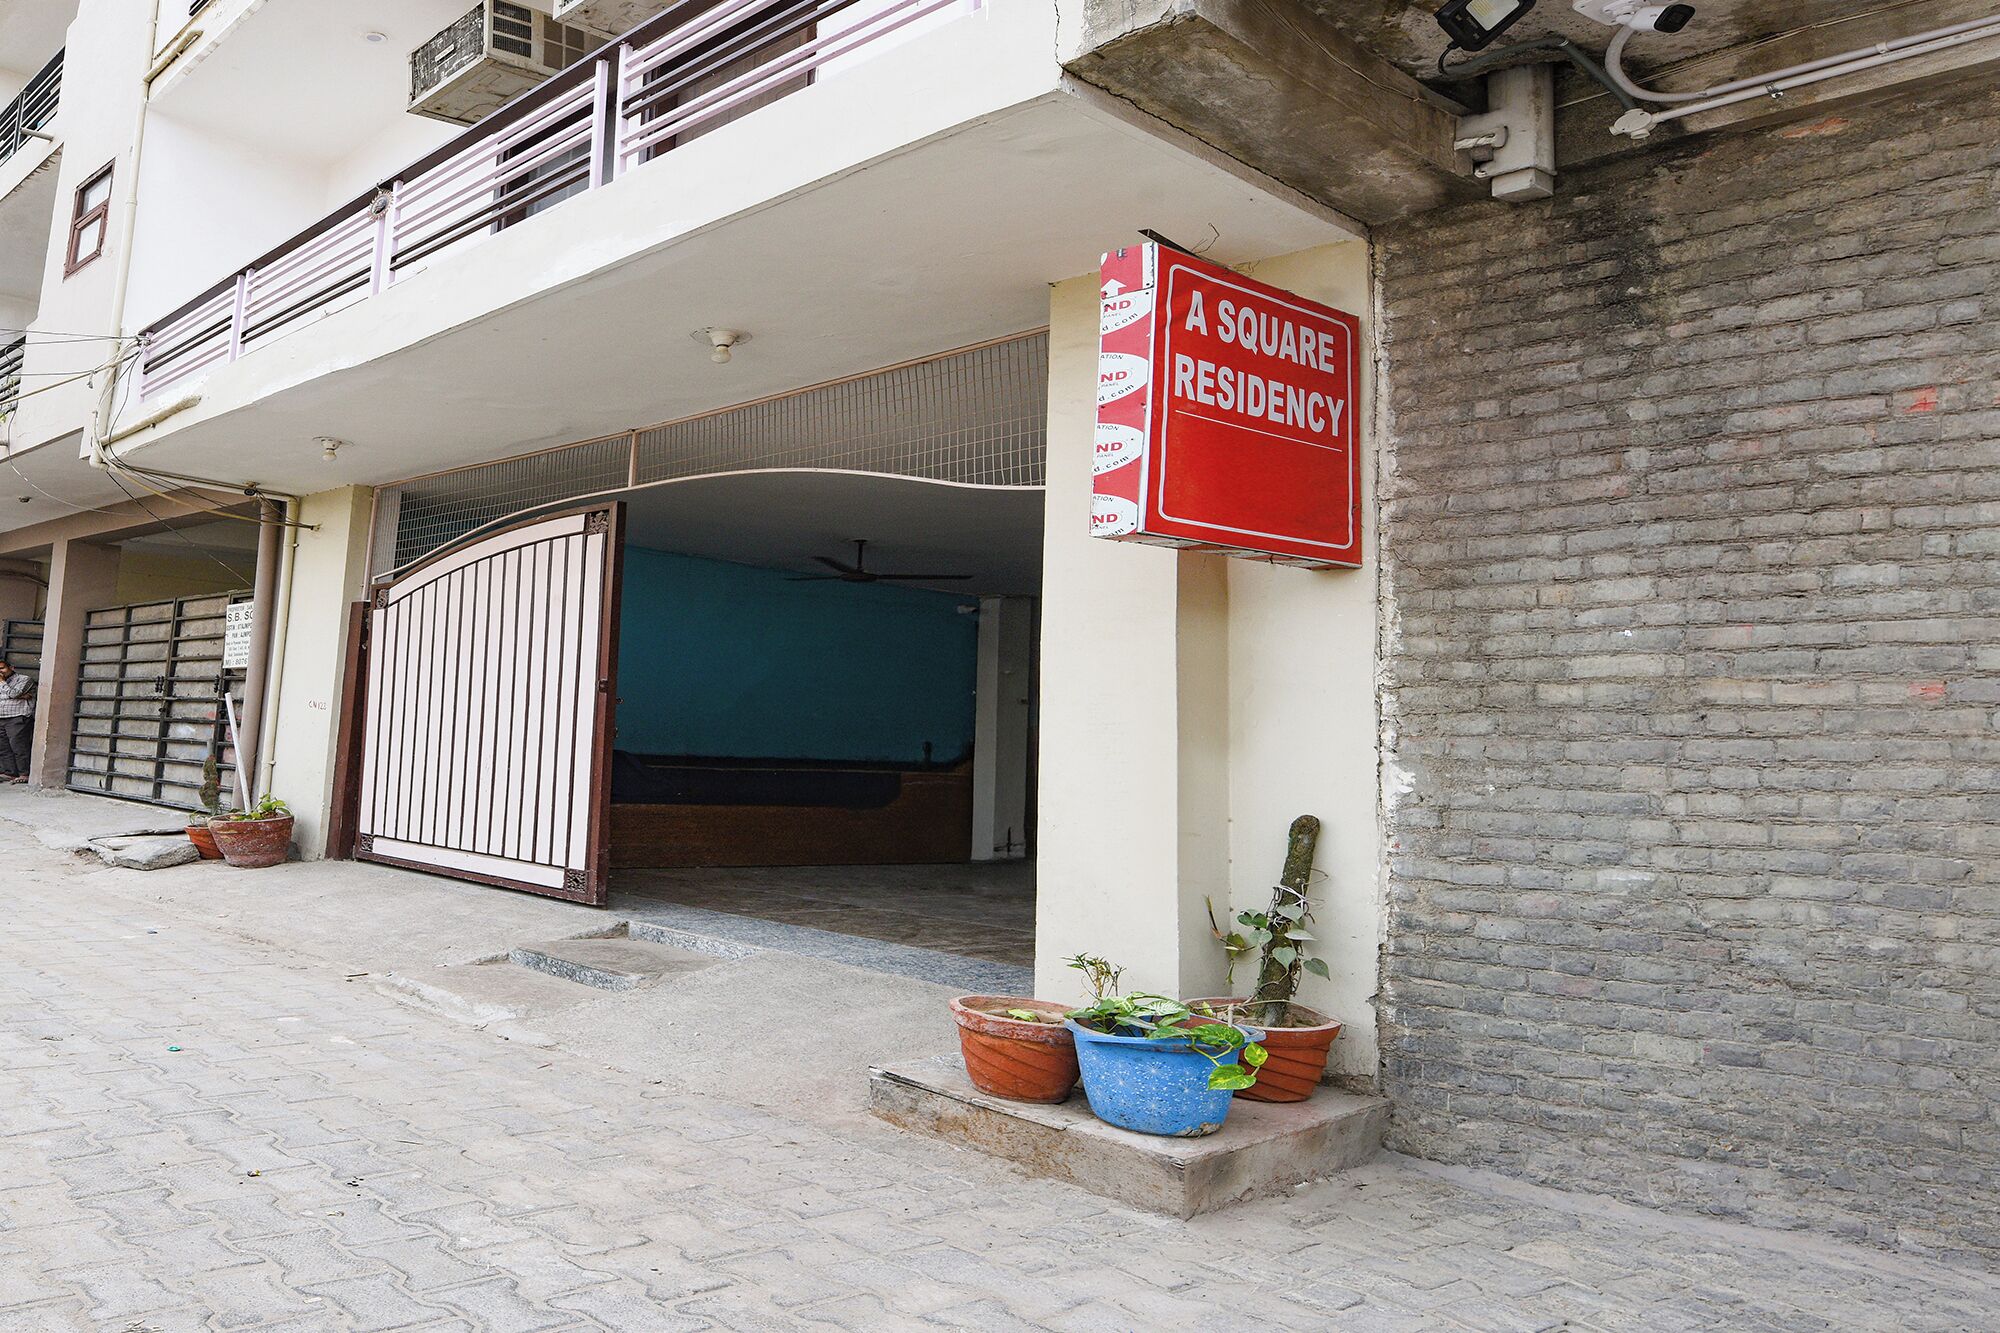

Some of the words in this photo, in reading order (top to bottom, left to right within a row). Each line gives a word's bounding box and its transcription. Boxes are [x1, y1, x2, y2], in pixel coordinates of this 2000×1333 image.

[1185, 290, 1208, 336] A
[1217, 299, 1335, 374] SQUARE
[1101, 371, 1127, 382] ND
[1174, 352, 1345, 437] RESIDENCY
[1096, 442, 1123, 453] ND
